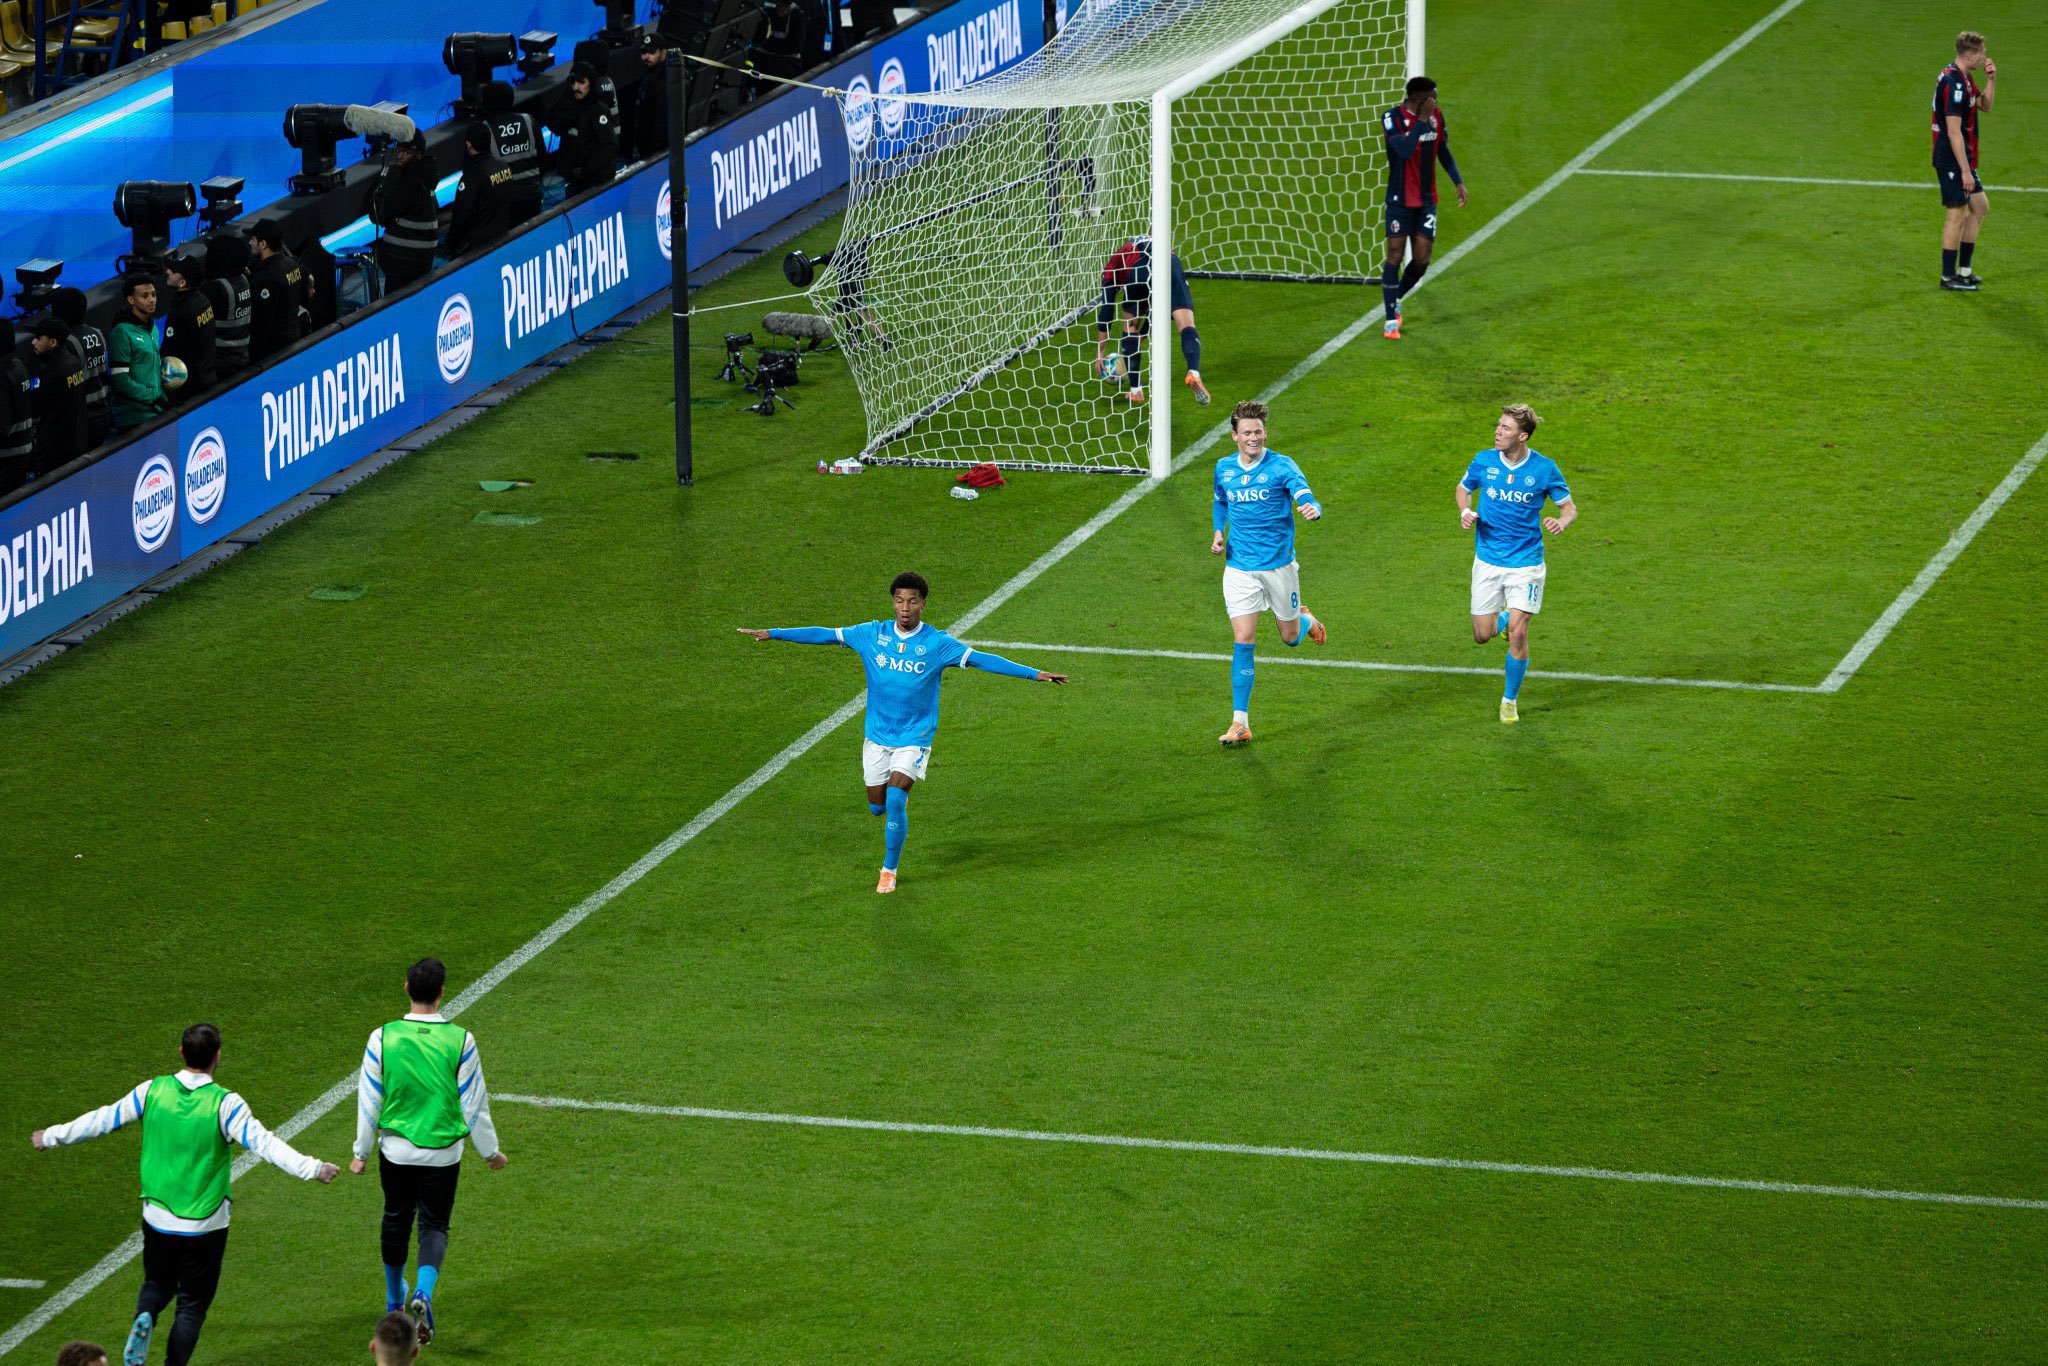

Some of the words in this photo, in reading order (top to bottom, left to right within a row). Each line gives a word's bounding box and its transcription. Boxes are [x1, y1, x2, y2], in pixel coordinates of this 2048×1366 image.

[927, 0, 1022, 94] PHILADELPHIA
[498, 122, 521, 137] 267
[501, 140, 529, 155] Guard
[490, 168, 513, 186] POLICE
[711, 106, 822, 230] PHILADELPHIA
[501, 211, 629, 350] PHILADELPHIA
[235, 305, 252, 318] Guar
[82, 334, 102, 349] 232
[438, 321, 472, 354] PHILADELPHIA
[67, 370, 84, 389] POLIC
[261, 333, 405, 481] PHILADELPHIA
[186, 457, 225, 495] PHILADELPHIA
[134, 485, 174, 524] PHILADELPHIA
[1235, 489, 1270, 503] MSC
[1499, 488, 1534, 503] MSC
[1291, 591, 1298, 609] 8
[1528, 583, 1539, 602] 19
[888, 657, 926, 674] MSC
